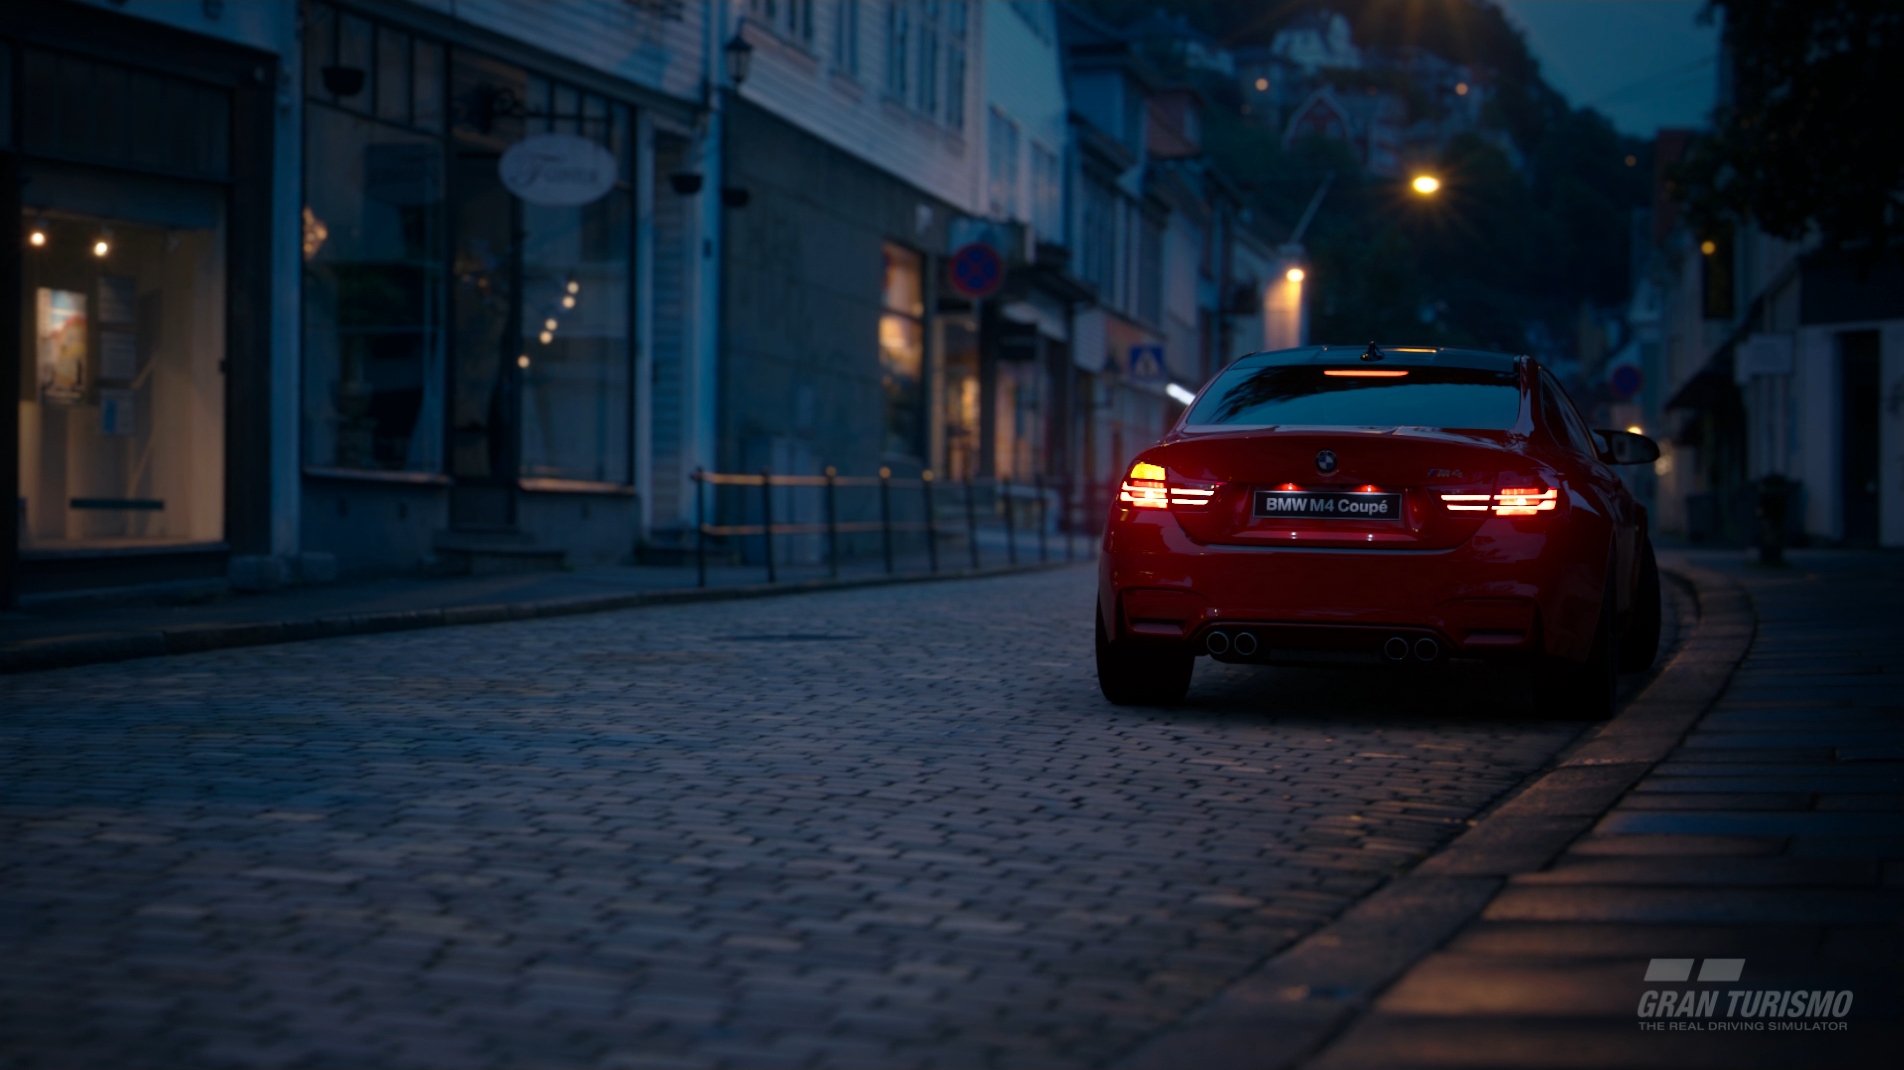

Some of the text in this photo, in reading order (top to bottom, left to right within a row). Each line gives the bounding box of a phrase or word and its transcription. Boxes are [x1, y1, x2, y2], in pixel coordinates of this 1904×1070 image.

[1266, 497, 1389, 516] BMW M4 Coupé
